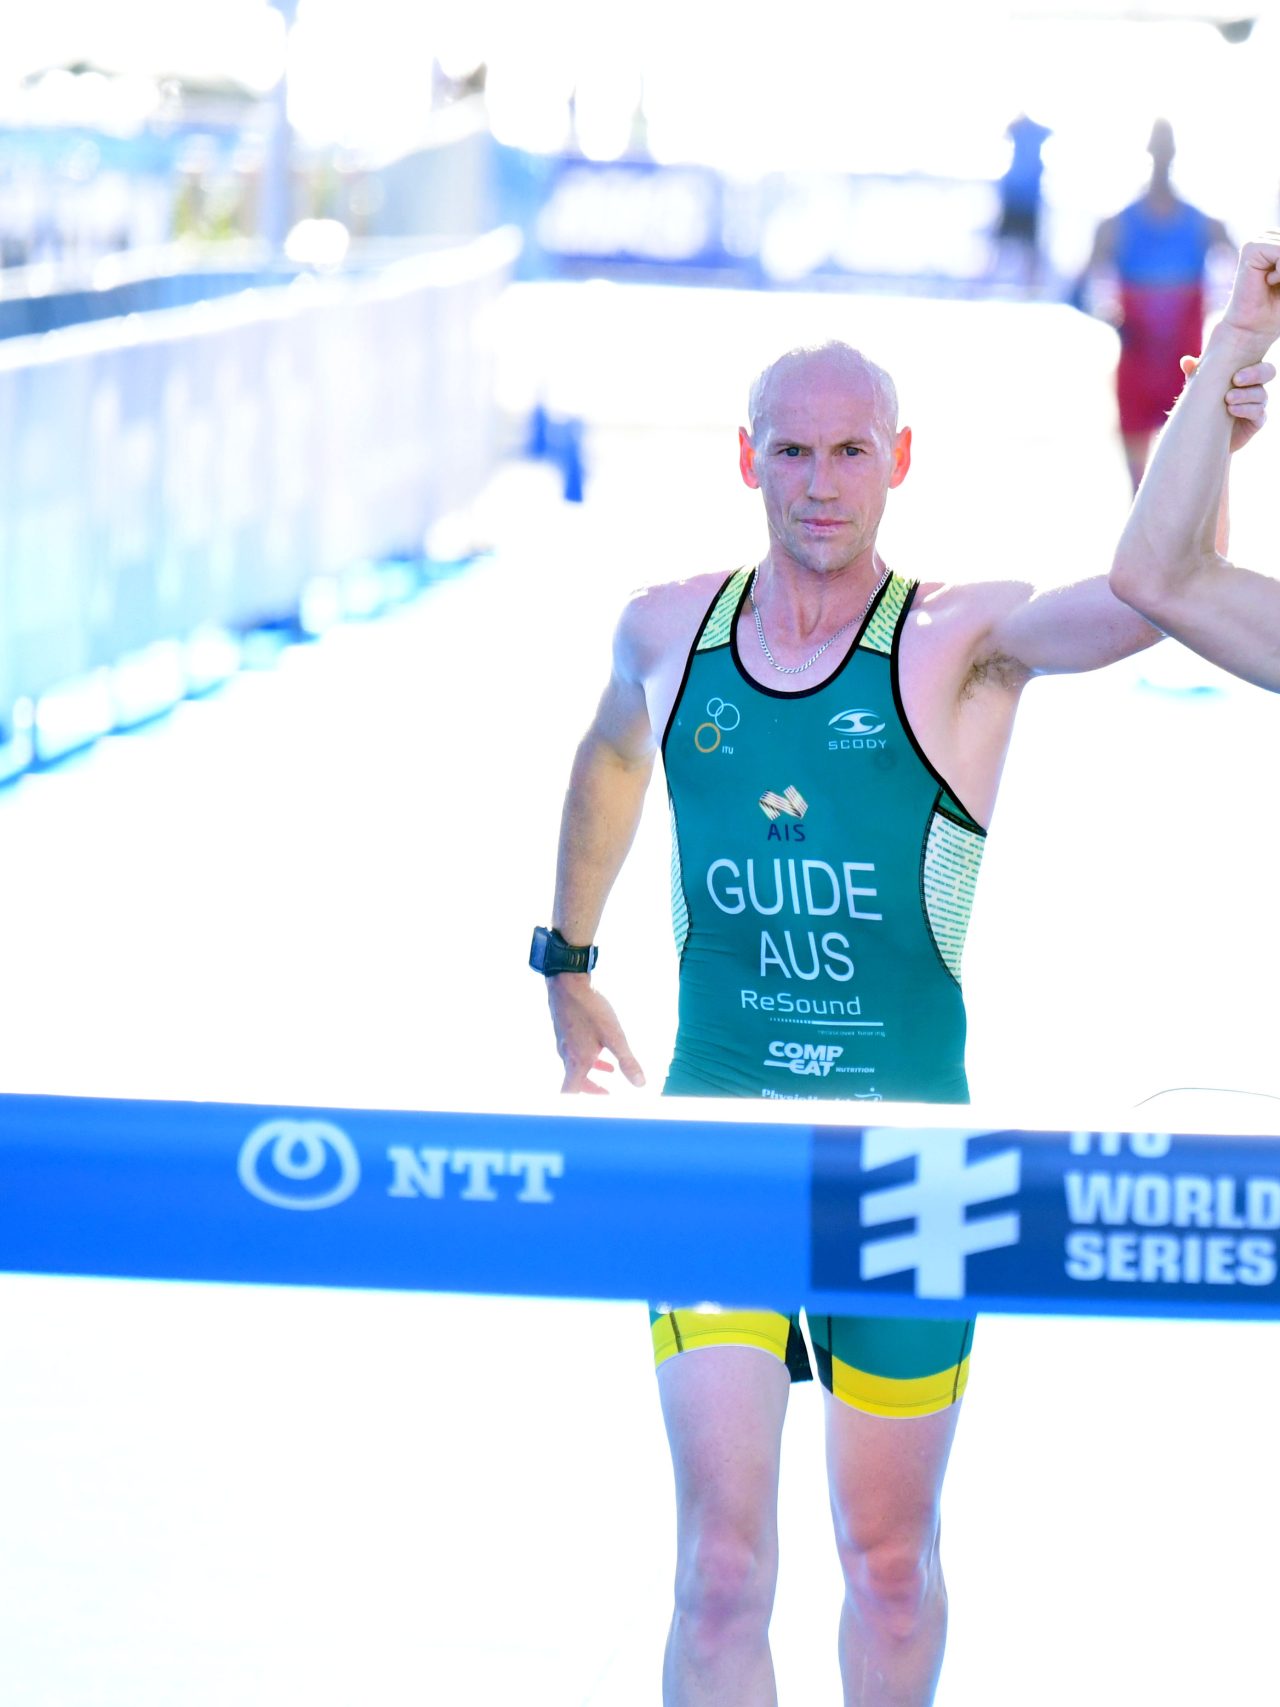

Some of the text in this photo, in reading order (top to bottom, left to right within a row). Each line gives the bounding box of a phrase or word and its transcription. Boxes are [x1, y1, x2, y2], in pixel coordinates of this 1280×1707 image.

[721, 745, 734, 755] ITU
[828, 738, 888, 750] SCODY
[767, 823, 806, 842] AIS
[706, 858, 883, 921] GUIDE
[760, 930, 855, 982] AUS
[740, 989, 862, 1016] ReSound
[768, 1040, 844, 1062] COMP
[787, 1058, 836, 1077] EAT
[386, 1145, 564, 1203] NTT
[1064, 1229, 1278, 1286] SERIES
